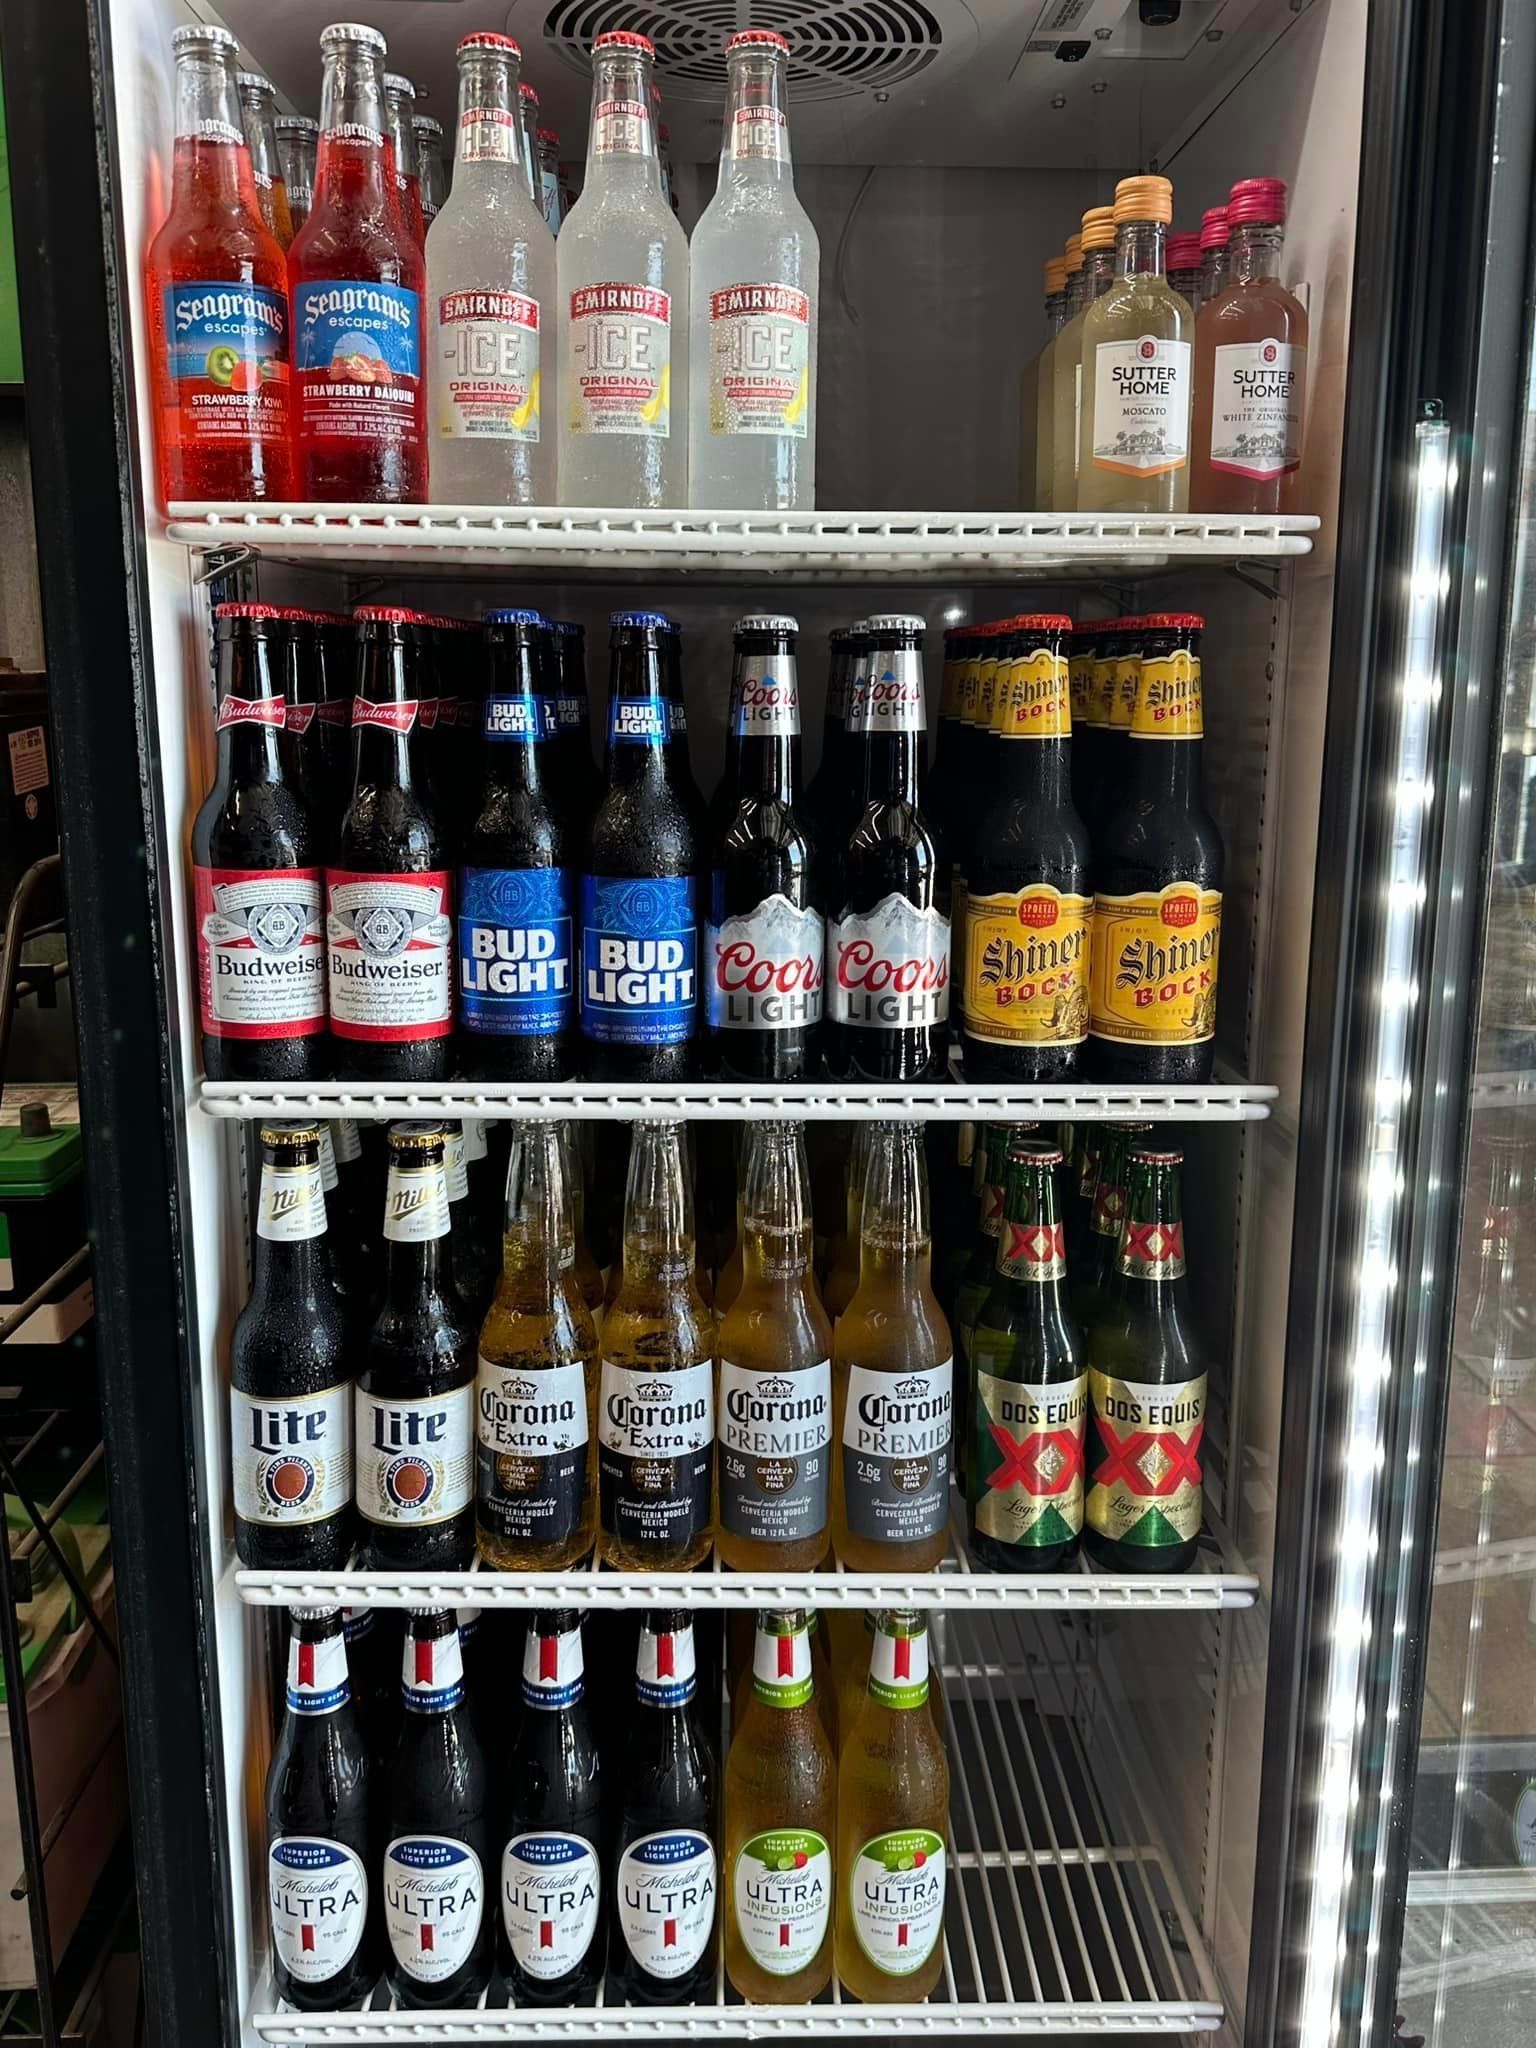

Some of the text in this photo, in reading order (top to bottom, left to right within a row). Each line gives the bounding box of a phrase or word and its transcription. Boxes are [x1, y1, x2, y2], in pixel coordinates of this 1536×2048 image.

[304, 288, 412, 329] Seagram's
[445, 294, 531, 322] SMIRNOFF
[575, 288, 663, 313] SMIRNOFF
[718, 288, 803, 313] SMIRNOFF
[176, 293, 284, 335] Seagram's
[204, 322, 265, 337] escapes
[328, 316, 389, 331] escapes
[456, 328, 522, 379] ICE
[586, 323, 653, 373] ICE
[580, 375, 659, 388] ORIGINAL
[723, 376, 799, 387] ORIGINAL
[1112, 366, 1177, 381] SUTTER
[1233, 370, 1296, 384] SUTTER
[303, 384, 415, 404] STRAWBERRY DAIQUIRI
[449, 382, 528, 393] ORIGINAL
[1119, 382, 1170, 396] HOME
[1241, 385, 1290, 398] HOME
[191, 394, 263, 406] STRAWBERRY
[1122, 407, 1167, 416] MOSCATO
[1223, 414, 1252, 423] WHITE
[739, 680, 798, 706] Coors
[865, 674, 921, 701] Coors
[222, 700, 286, 719] Budweiser
[352, 702, 414, 721] Budweiser
[492, 704, 528, 718] BUD
[620, 706, 657, 720] BUD
[743, 706, 796, 721] LIGHT
[1016, 700, 1067, 723] BOCK
[487, 717, 536, 732] LIGHT
[614, 719, 664, 734] LIGHT
[1023, 903, 1056, 913] SPOETZL
[1164, 903, 1197, 913] SPOETZL
[471, 927, 556, 961] BUD
[599, 939, 685, 972] BUD
[979, 927, 1087, 986] Shiner
[332, 955, 442, 980] Budweiser
[462, 957, 569, 993] LIGHT
[716, 941, 824, 993] Coors
[838, 940, 948, 993] Coors
[588, 969, 694, 1005] LIGHT
[994, 972, 1076, 1007] BOCK
[1134, 969, 1212, 1008] BOCK
[727, 993, 822, 1022] LIGHT
[847, 992, 942, 1023] LIGHT
[480, 1387, 575, 1427] Corona
[607, 1393, 706, 1433] Corona
[727, 1388, 824, 1428] Corona
[1002, 1401, 1040, 1424] DOS
[1106, 1396, 1200, 1426] DOS EQUIS
[248, 1406, 327, 1455] Lite
[370, 1406, 447, 1455] Lite
[495, 1422, 548, 1447] Extra
[629, 1427, 684, 1449] Extra
[727, 1424, 826, 1453] PREMIER
[726, 1455, 746, 1479] 2.6g
[805, 1458, 819, 1476] 90
[894, 1465, 929, 1475] CERVEZA
[906, 1460, 916, 1468] LA
[937, 1453, 947, 1471] 90
[756, 1467, 793, 1475] CERVEZA
[766, 1474, 784, 1482] MAS
[857, 1460, 881, 1482] 2.6g
[903, 1474, 920, 1482] MAS
[902, 1481, 920, 1489] FINA
[526, 1507, 554, 1517] MODELO
[621, 1507, 690, 1519] CERVECERIA MODELO
[741, 1505, 781, 1517] CERVECERIA
[875, 1508, 918, 1518] CERVECERIA
[1110, 1496, 1145, 1519] Lager
[642, 1518, 668, 1527] MEXICO
[761, 1517, 788, 1525] MEXICO
[898, 1515, 924, 1526] MEXICO
[640, 1530, 648, 1538] 12
[770, 1528, 777, 1536] 12
[886, 1528, 914, 1537] BEER 12
[303, 1697, 326, 1706] LIGHT
[546, 1691, 568, 1700] LIGHT
[664, 1688, 685, 1698] LIGHT
[524, 1842, 569, 1852] SUPERIOR
[647, 1839, 692, 1851] SUPERIOR
[766, 1838, 806, 1846] SUPERIOR
[789, 1842, 809, 1850] BEER
[884, 1841, 928, 1851] LIGHT BEER
[887, 1837, 926, 1846] SUPERIOR
[280, 1854, 331, 1865] LIGHT BEER
[283, 1847, 326, 1856] SUPERIOR
[400, 1853, 452, 1864] LIGHT BEER
[403, 1846, 447, 1856] SUPERIOR
[522, 1850, 573, 1860] LIGHT BEER
[644, 1847, 695, 1860] LIGHT BEER
[278, 1875, 339, 1894] Michelob
[395, 1875, 459, 1893] Michelob
[514, 1870, 579, 1889] Michelob
[636, 1868, 700, 1889] Michelob
[756, 1869, 810, 1885] Michelob
[875, 1869, 929, 1885] Michelob
[506, 1881, 595, 1914] ULTRA
[625, 1877, 714, 1914] ULTRA
[746, 1879, 823, 1904] ULTRA
[865, 1877, 939, 1904] ULTRA
[271, 1884, 360, 1918] ULTRA
[387, 1883, 477, 1918] ULTRA
[747, 1896, 823, 1916] INFUSIONS
[864, 1894, 938, 1915] INFUSIONS
